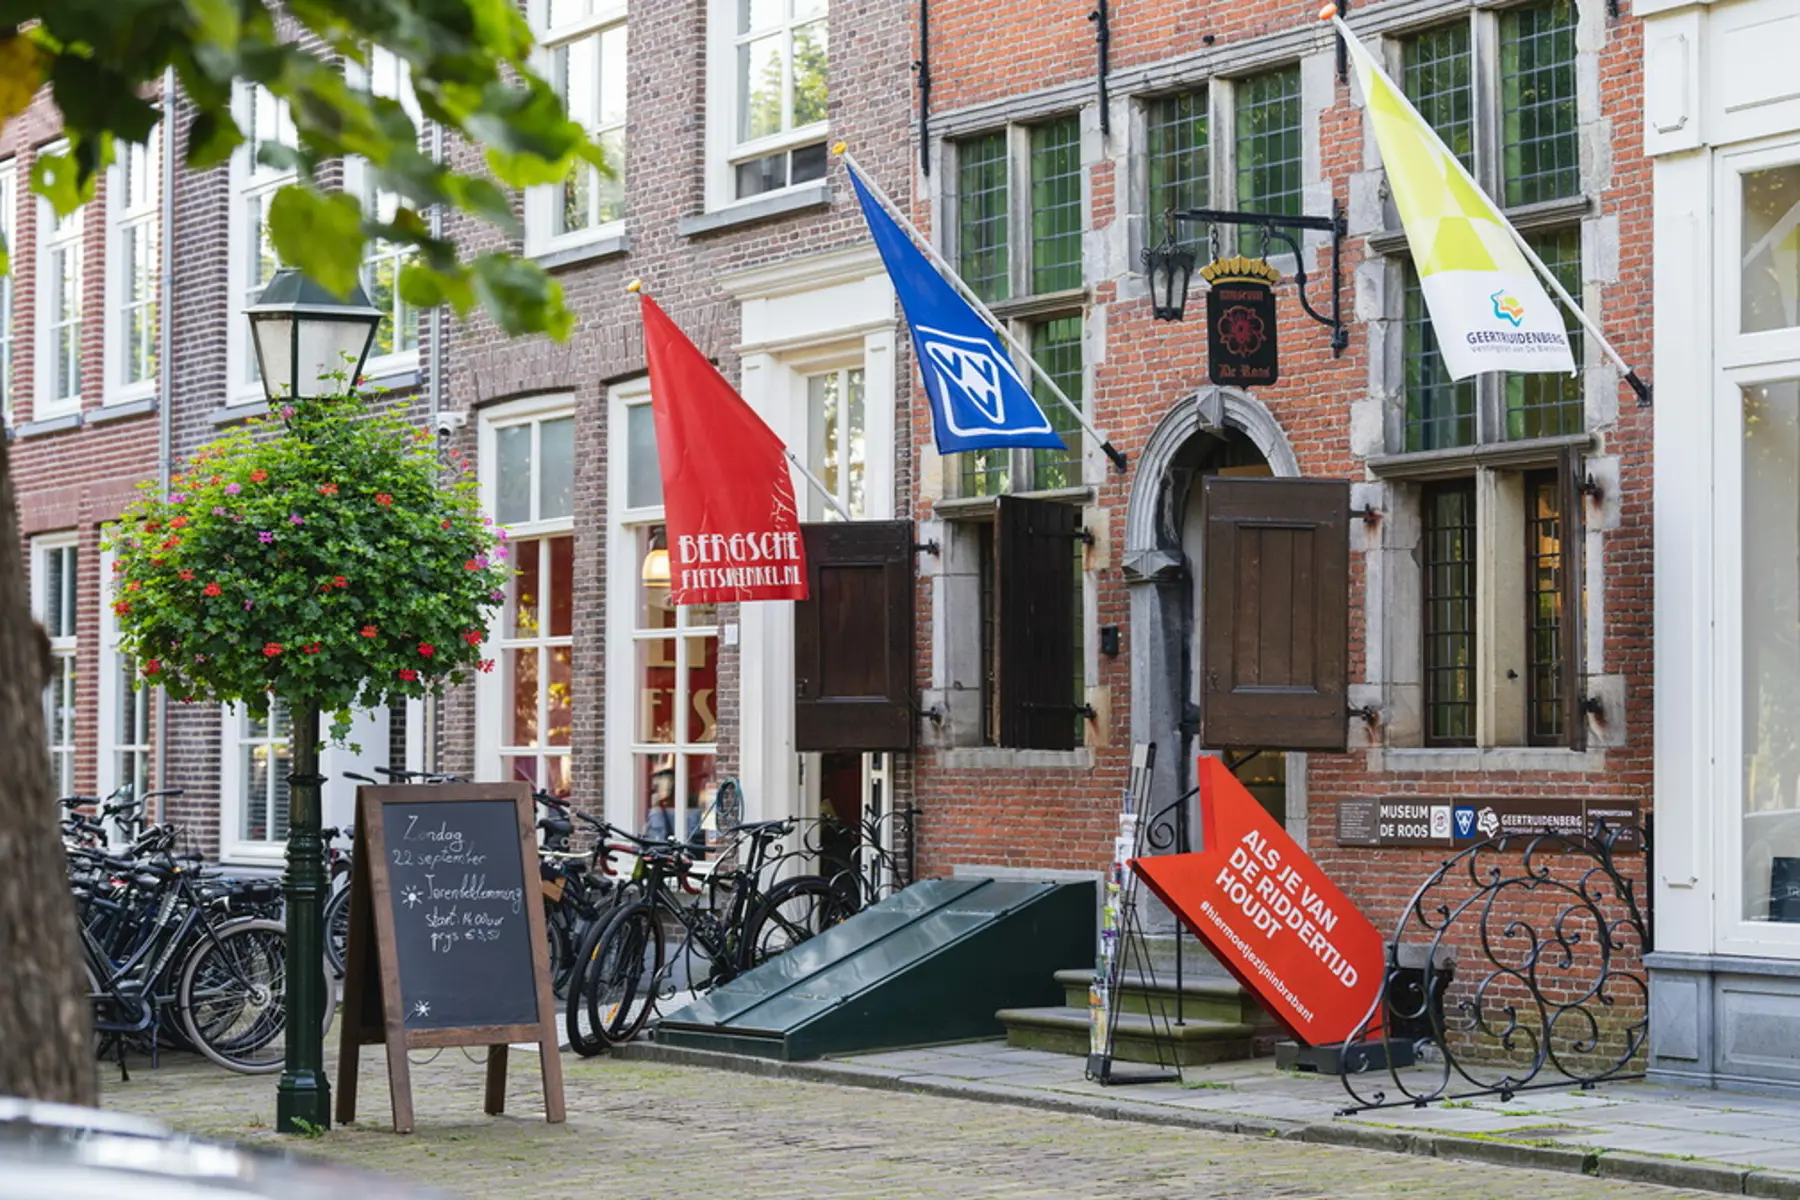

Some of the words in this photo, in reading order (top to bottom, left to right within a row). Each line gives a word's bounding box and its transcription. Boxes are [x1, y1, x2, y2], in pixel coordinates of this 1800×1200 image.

[1466, 331, 1565, 345] GEERTRUIDENBERG
[678, 531, 801, 564] BERGSCHE
[1380, 805, 1429, 819] MUSEUM
[1501, 814, 1582, 827] GEERTRUIDENBERG
[402, 815, 464, 852] Zondag
[1380, 824, 1395, 837] DE
[1397, 824, 1429, 838] ROOS
[392, 849, 414, 866] 22
[1242, 830, 1281, 870] ALS
[1276, 865, 1303, 894] JE
[1300, 886, 1338, 933] VAN
[1215, 867, 1283, 940] HOUDT
[1229, 847, 1260, 883] DE
[1256, 876, 1358, 988] RIDDERTIJD
[1200, 900, 1314, 1023] #hiermoetjezijninbrabant
